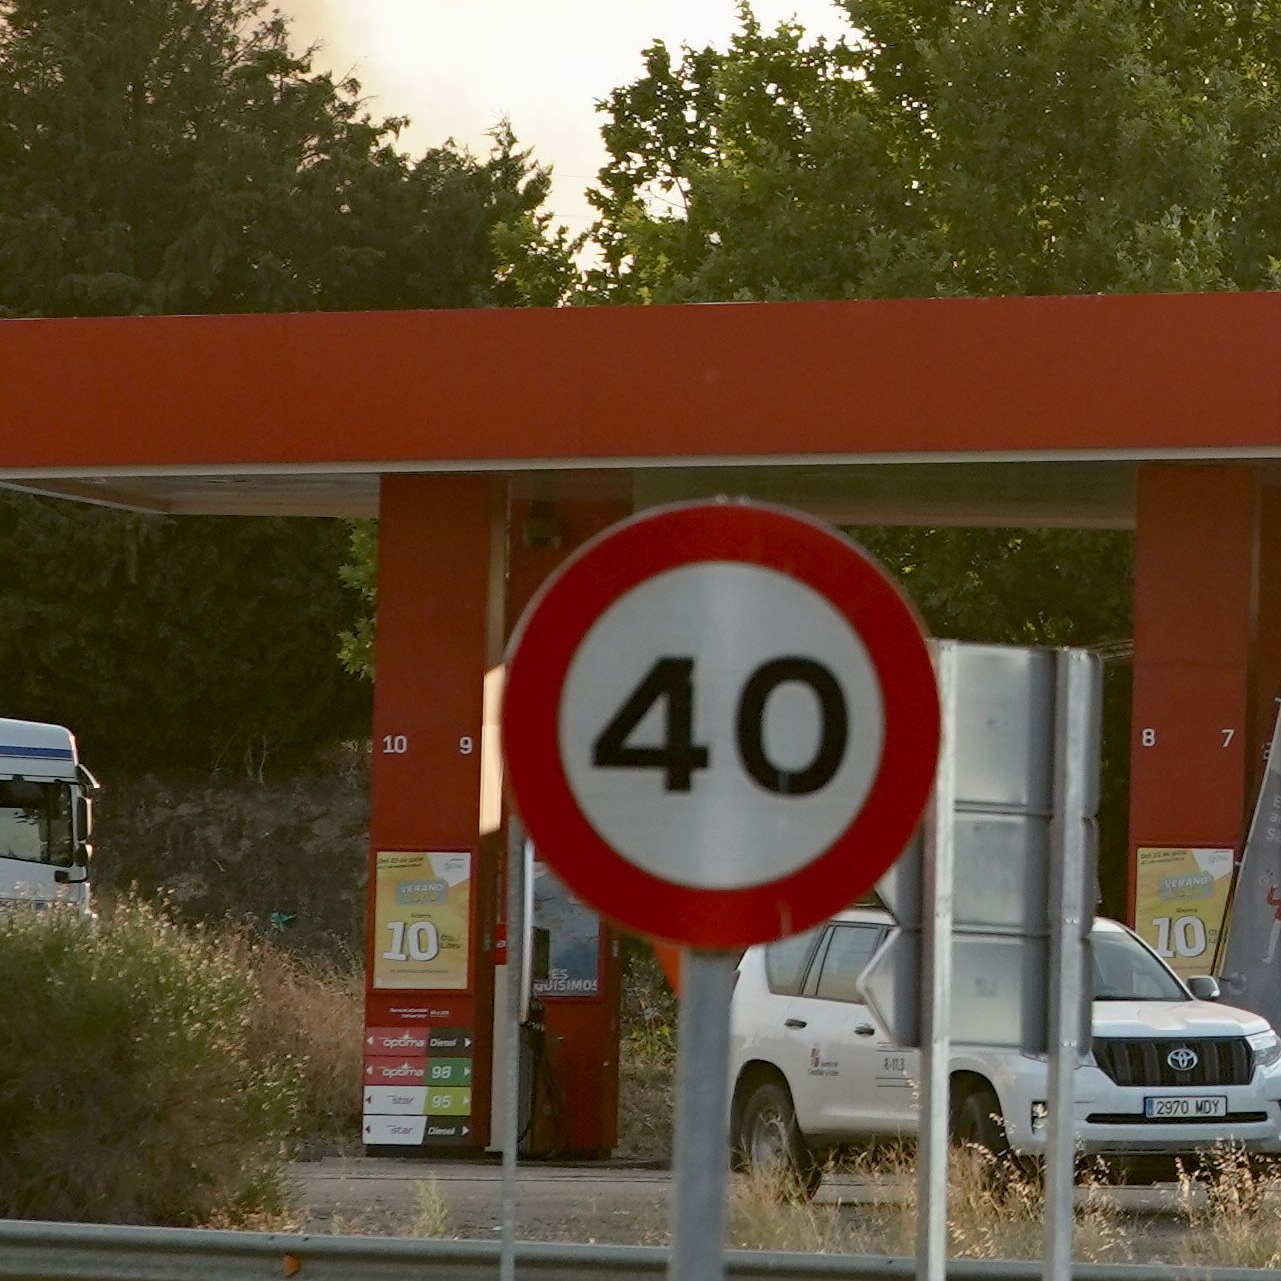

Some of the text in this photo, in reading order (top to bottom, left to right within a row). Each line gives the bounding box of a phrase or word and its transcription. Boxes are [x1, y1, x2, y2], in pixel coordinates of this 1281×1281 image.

[592, 654, 848, 796] 40
[383, 735, 408, 754] 10
[459, 736, 472, 755] 9
[1142, 728, 1155, 747] 8
[1221, 728, 1234, 748] 7
[1164, 877, 1209, 888] VERANO
[383, 920, 439, 961] 10
[1151, 916, 1207, 958] 10
[430, 1038, 457, 1048] Diesel
[431, 1065, 453, 1079] 98
[431, 1095, 453, 1109] 95
[1156, 1100, 1220, 1115] 2970 MDY
[427, 1125, 457, 1136] Diesel
